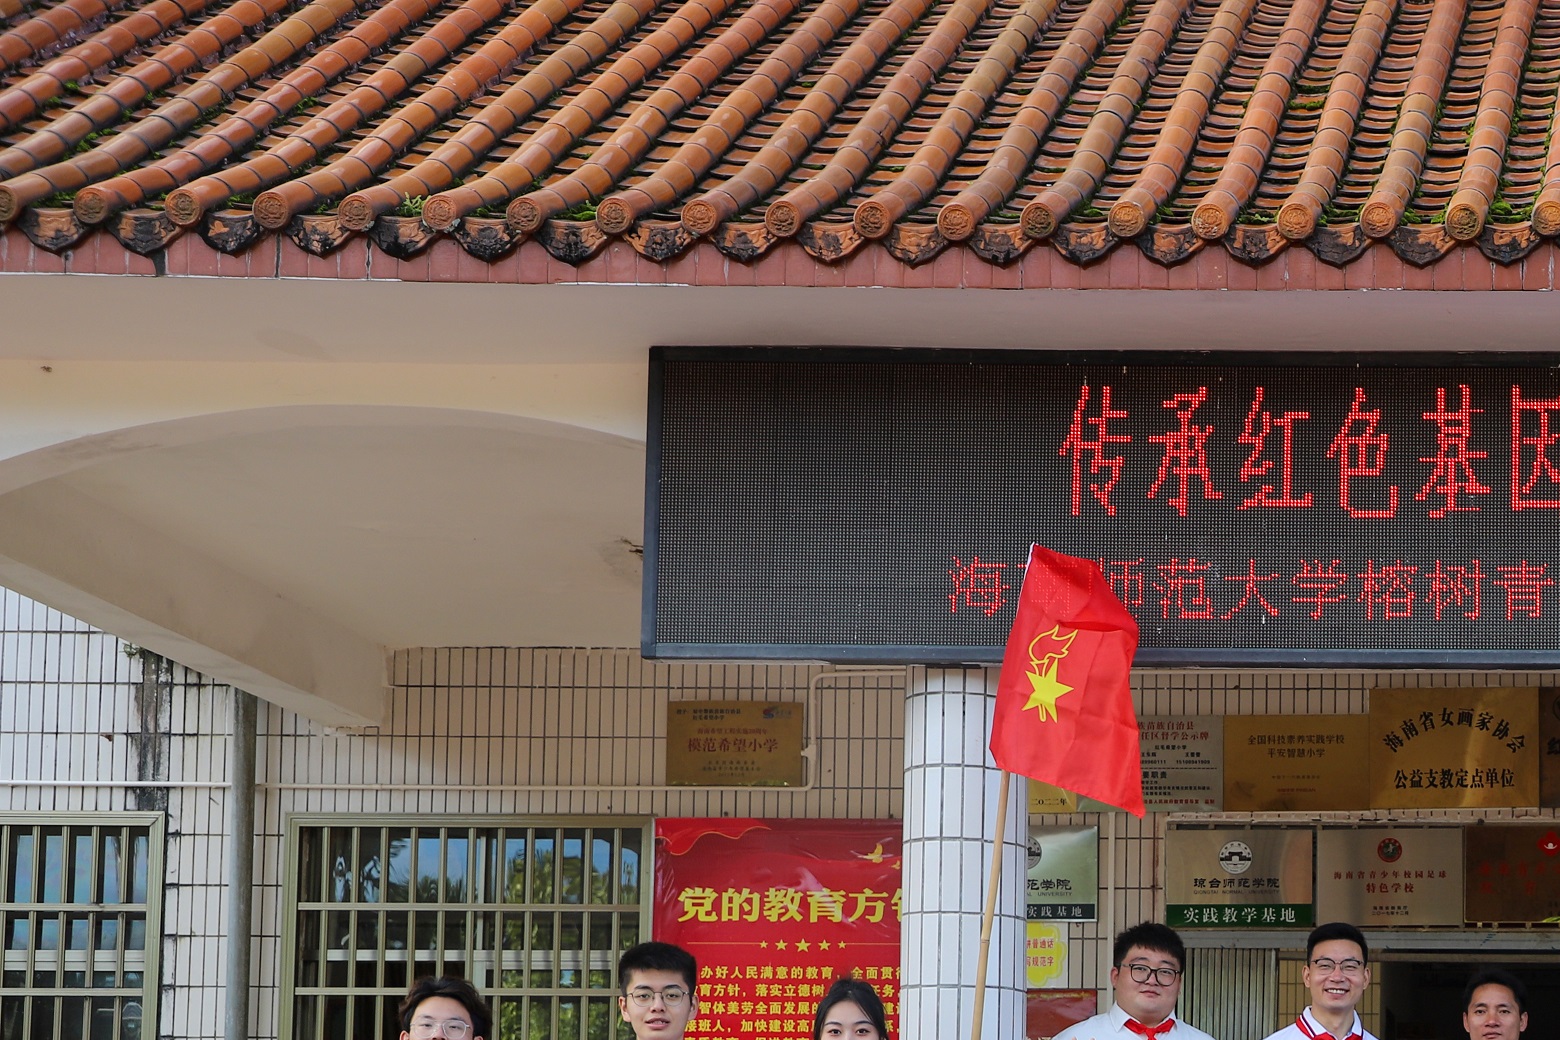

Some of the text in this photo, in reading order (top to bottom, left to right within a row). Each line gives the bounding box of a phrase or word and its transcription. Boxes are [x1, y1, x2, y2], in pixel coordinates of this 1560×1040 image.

[1382, 707, 1526, 753] 海南省女画家协会
[688, 737, 778, 753] 模范希望小学
[1248, 735, 1344, 745] 全国科技素养实践学校
[1268, 748, 1326, 758] 平安智慧小学
[1393, 768, 1515, 789] 公益支教定点单位
[1333, 870, 1448, 880] 海南省青少年校园足球
[1193, 878, 1280, 888] 琼台师范学院
[1366, 882, 1416, 894] 特色学校
[1027, 906, 1082, 918] 实践基地
[1184, 907, 1296, 924] 实践教学基地
